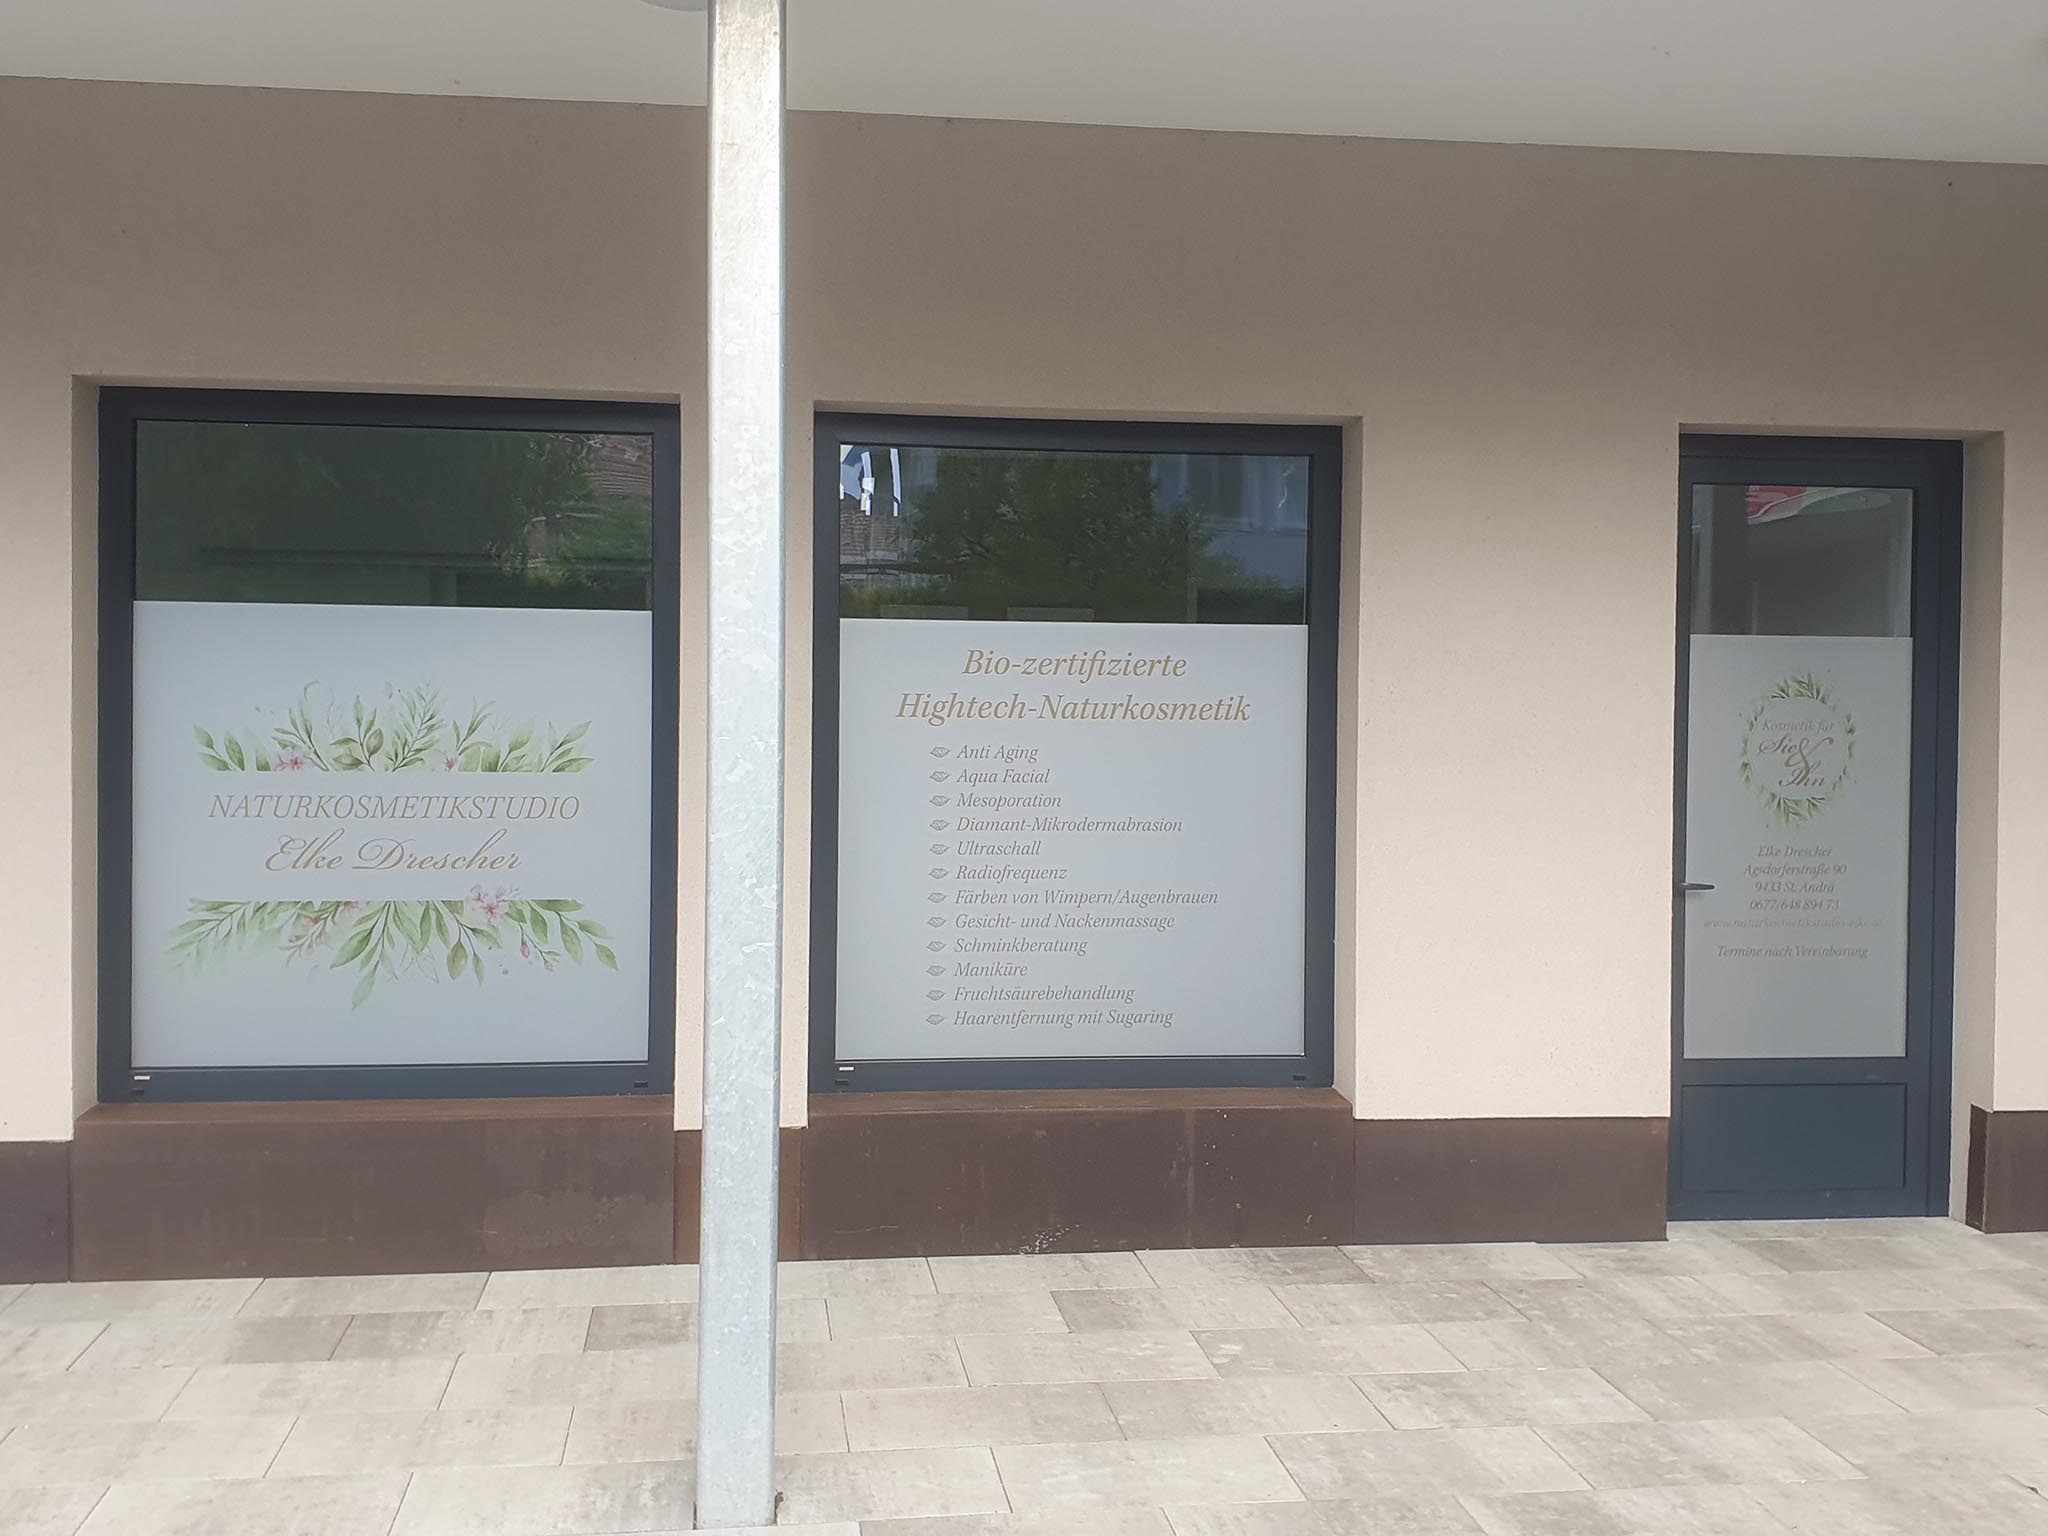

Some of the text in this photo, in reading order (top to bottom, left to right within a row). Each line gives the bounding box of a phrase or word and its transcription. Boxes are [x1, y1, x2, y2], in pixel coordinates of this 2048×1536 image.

[962, 649, 1188, 684] Bio-zertifizierte
[896, 692, 1251, 726] Hightech-Naturkosmetik
[1759, 732, 1798, 754] Sie
[956, 745, 1039, 764] Anti Aging
[956, 769, 1050, 786] Aqua Facial
[208, 793, 581, 820] NATURKOSMETIKSTUDIO
[956, 792, 1062, 811] Mesoporation
[956, 816, 1183, 832] Diamant-Mikrodermabrasion
[265, 828, 523, 872] Elke Drescher
[957, 840, 1041, 856] Ultraschall
[1758, 845, 1833, 857] Elke Drescher
[956, 865, 1068, 883] Radiofrequenz
[955, 889, 1219, 909] Färben von Wimpern/Augenbrauen
[955, 913, 1176, 932] Gesicht- und Nackenmassage
[954, 938, 1088, 957] Schminkberatung
[1717, 945, 1870, 960] Termine nach Vereinbarung
[954, 962, 1028, 977] Maniküre
[954, 985, 1135, 1004] Fruchtsäurebehandlung
[953, 1009, 1174, 1029] Haarentfernung mit Sugaring
